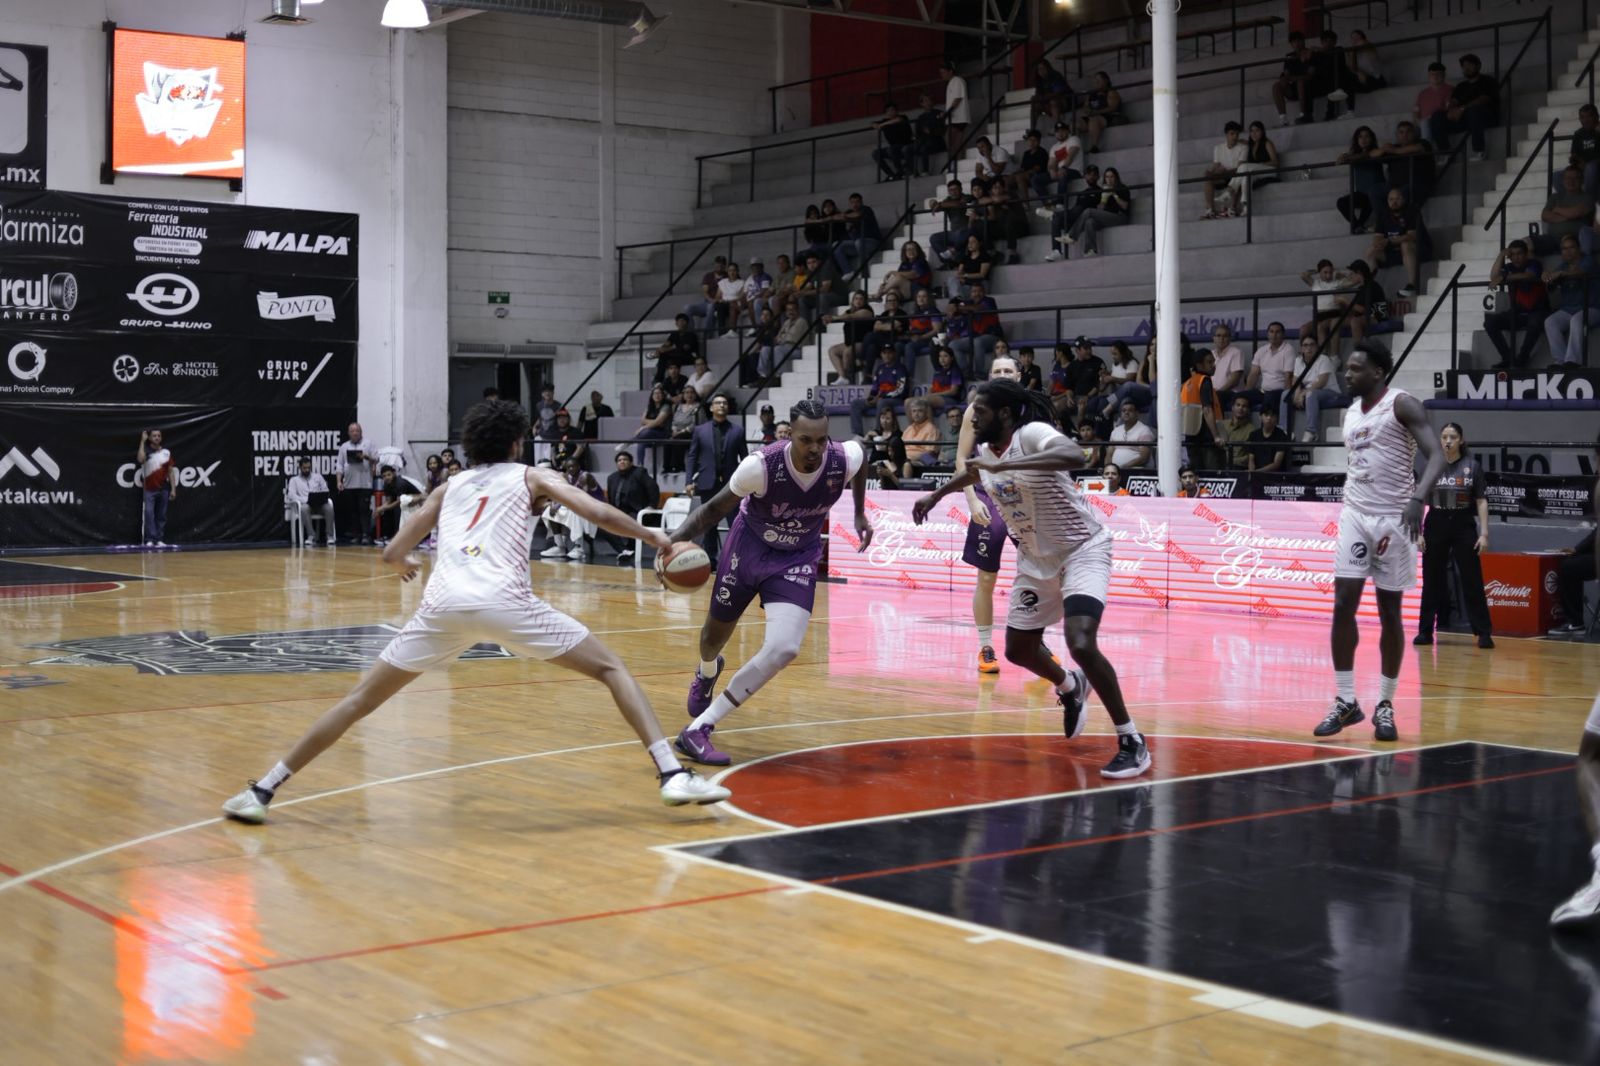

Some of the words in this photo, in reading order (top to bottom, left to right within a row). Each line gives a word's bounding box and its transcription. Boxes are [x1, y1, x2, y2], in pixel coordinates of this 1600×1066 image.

[0, 218, 83, 245] armiza
[151, 224, 208, 239] INDUSTRIAL
[243, 230, 348, 256] MALPA
[135, 255, 173, 263] ENCUENTRAS
[268, 299, 327, 315] PONTO
[1483, 294, 1494, 310] C
[120, 319, 162, 327] GRUPO
[266, 360, 308, 371] GRUPO
[258, 370, 299, 380] VEJAR
[1433, 372, 1444, 388] B
[40, 385, 74, 395] Company
[251, 430, 341, 451] TRANSPORTE
[254, 456, 280, 476] PEZ
[1576, 491, 1589, 499] BAR
[465, 496, 489, 532] 1
[1484, 580, 1532, 597] Caliente
